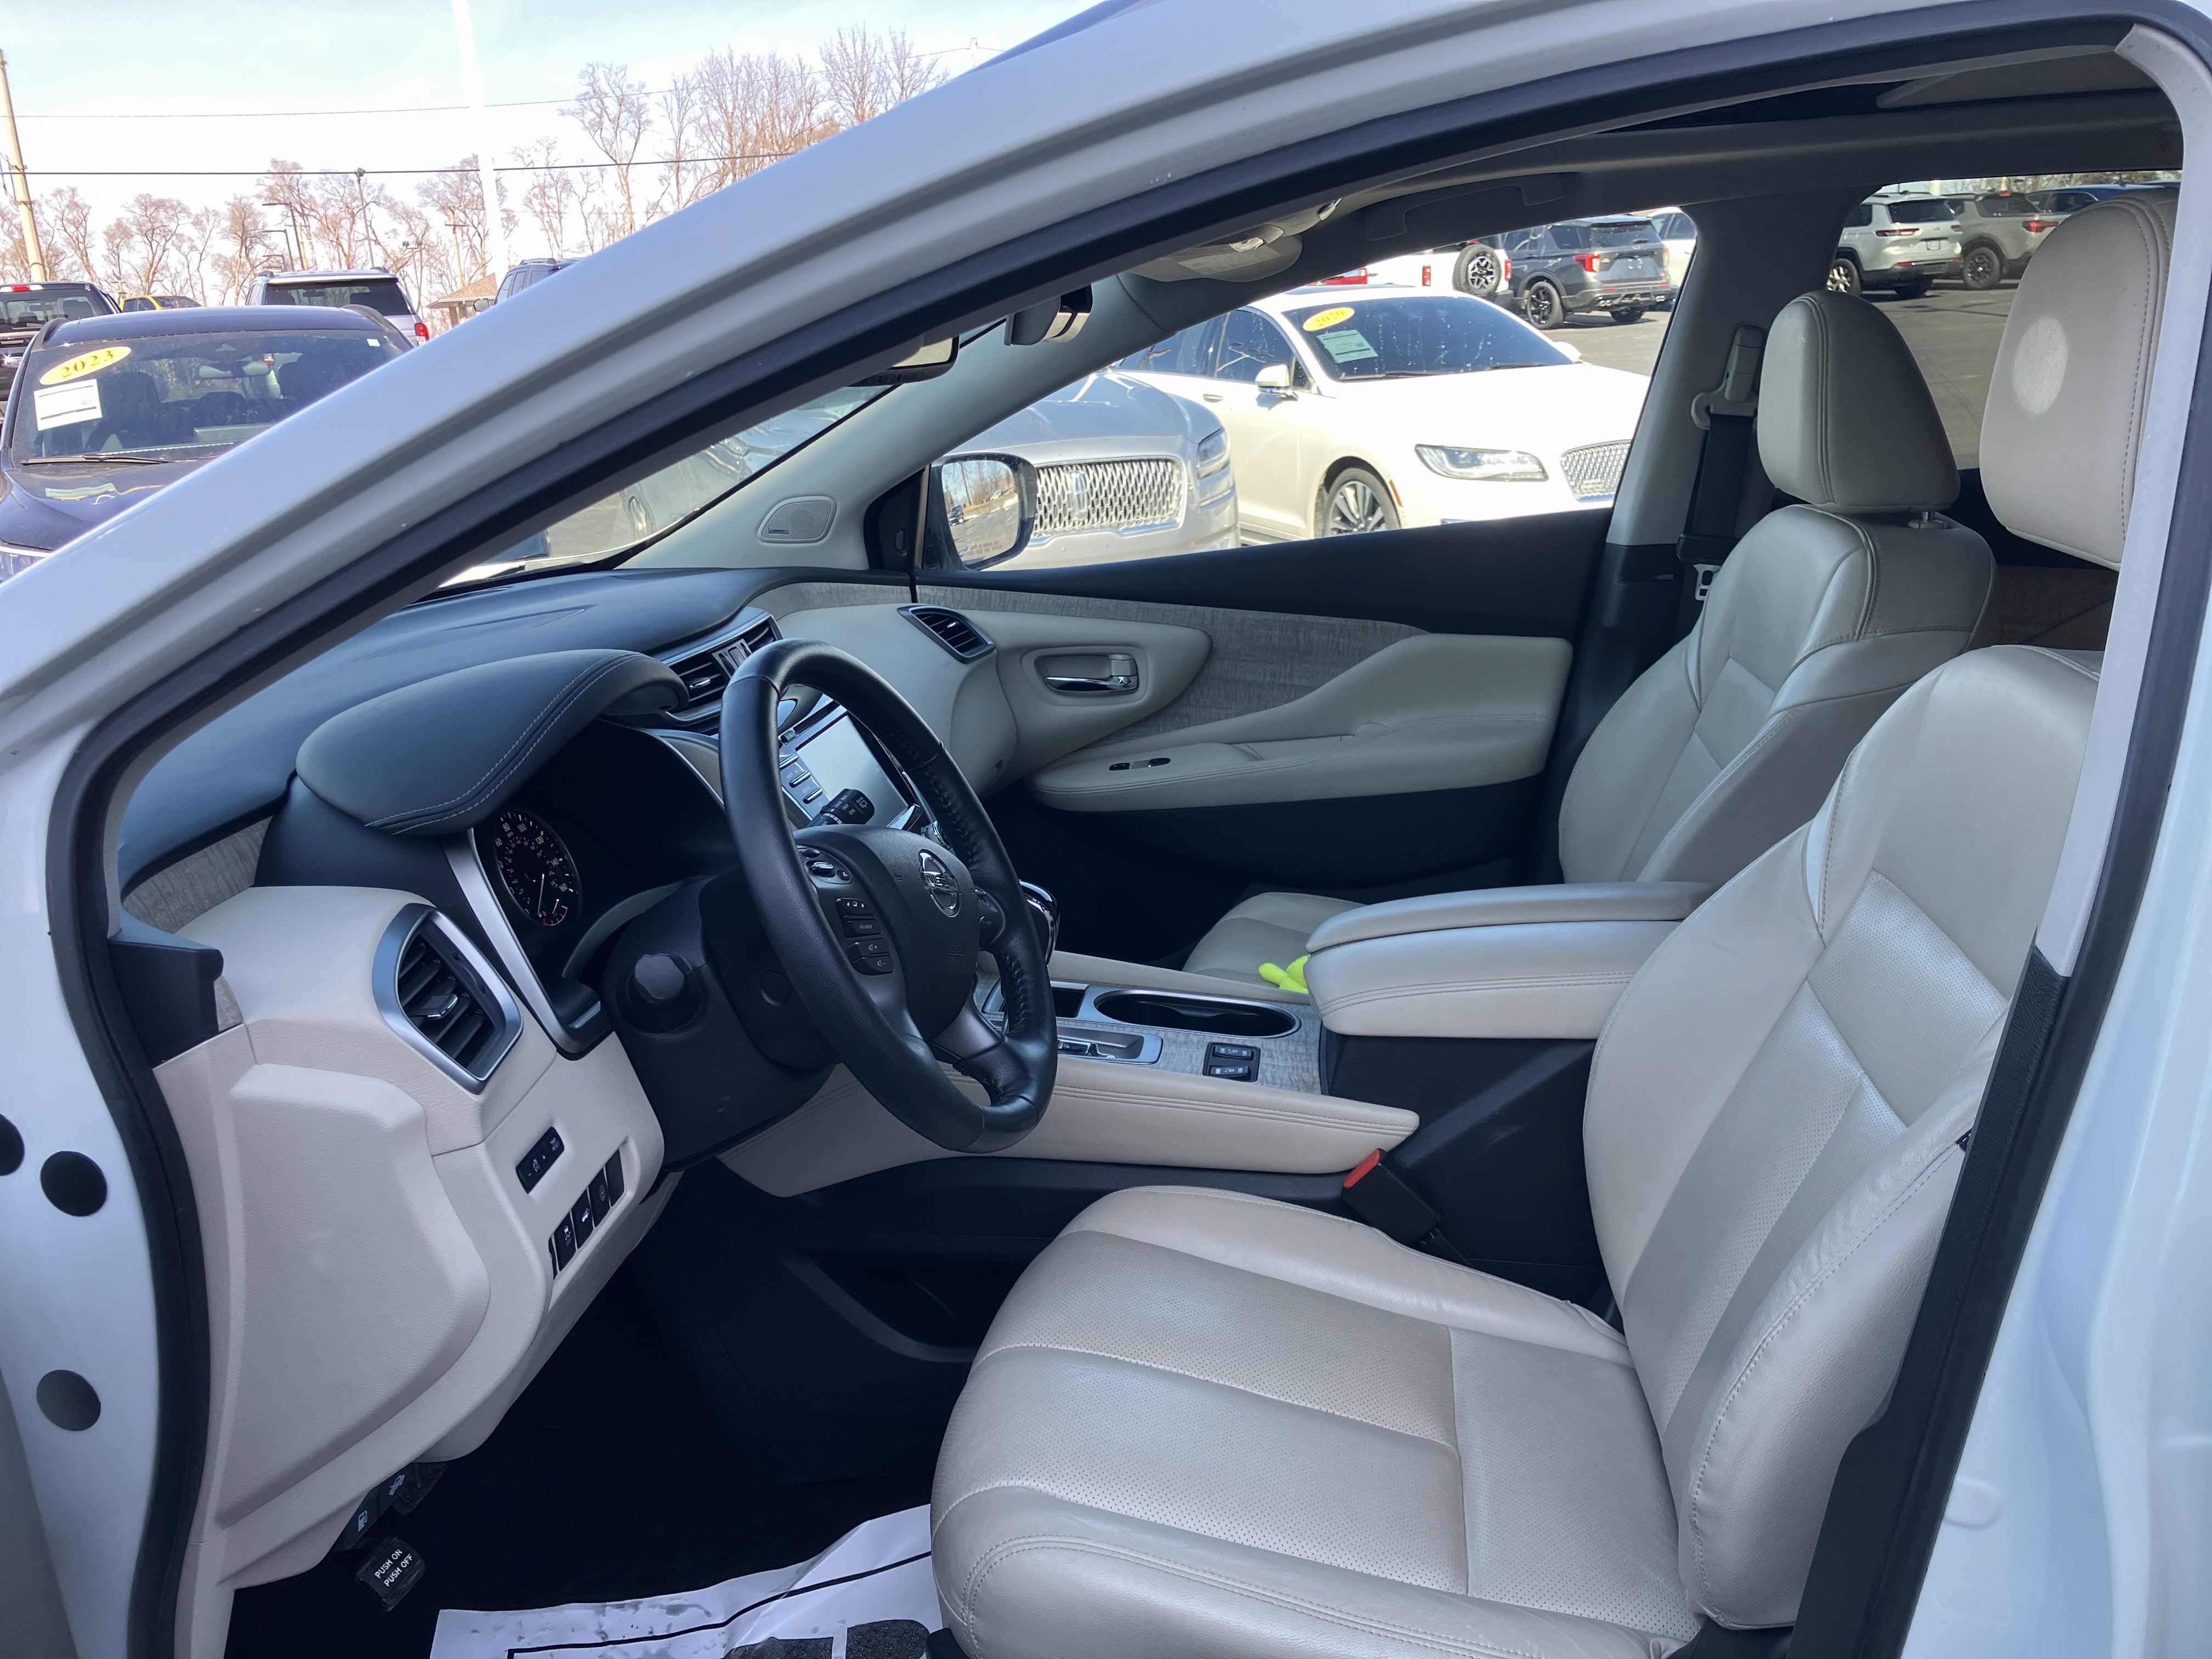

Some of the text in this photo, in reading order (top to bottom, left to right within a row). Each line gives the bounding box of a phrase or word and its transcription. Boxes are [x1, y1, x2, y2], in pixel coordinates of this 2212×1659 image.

[62, 350, 114, 379] 2023
[535, 836, 544, 845] 120
[550, 857, 560, 867] 140
[558, 883, 568, 893] 160
[374, 1549, 403, 1579] PUSH ON
[383, 1553, 413, 1587] PUSH OFF
